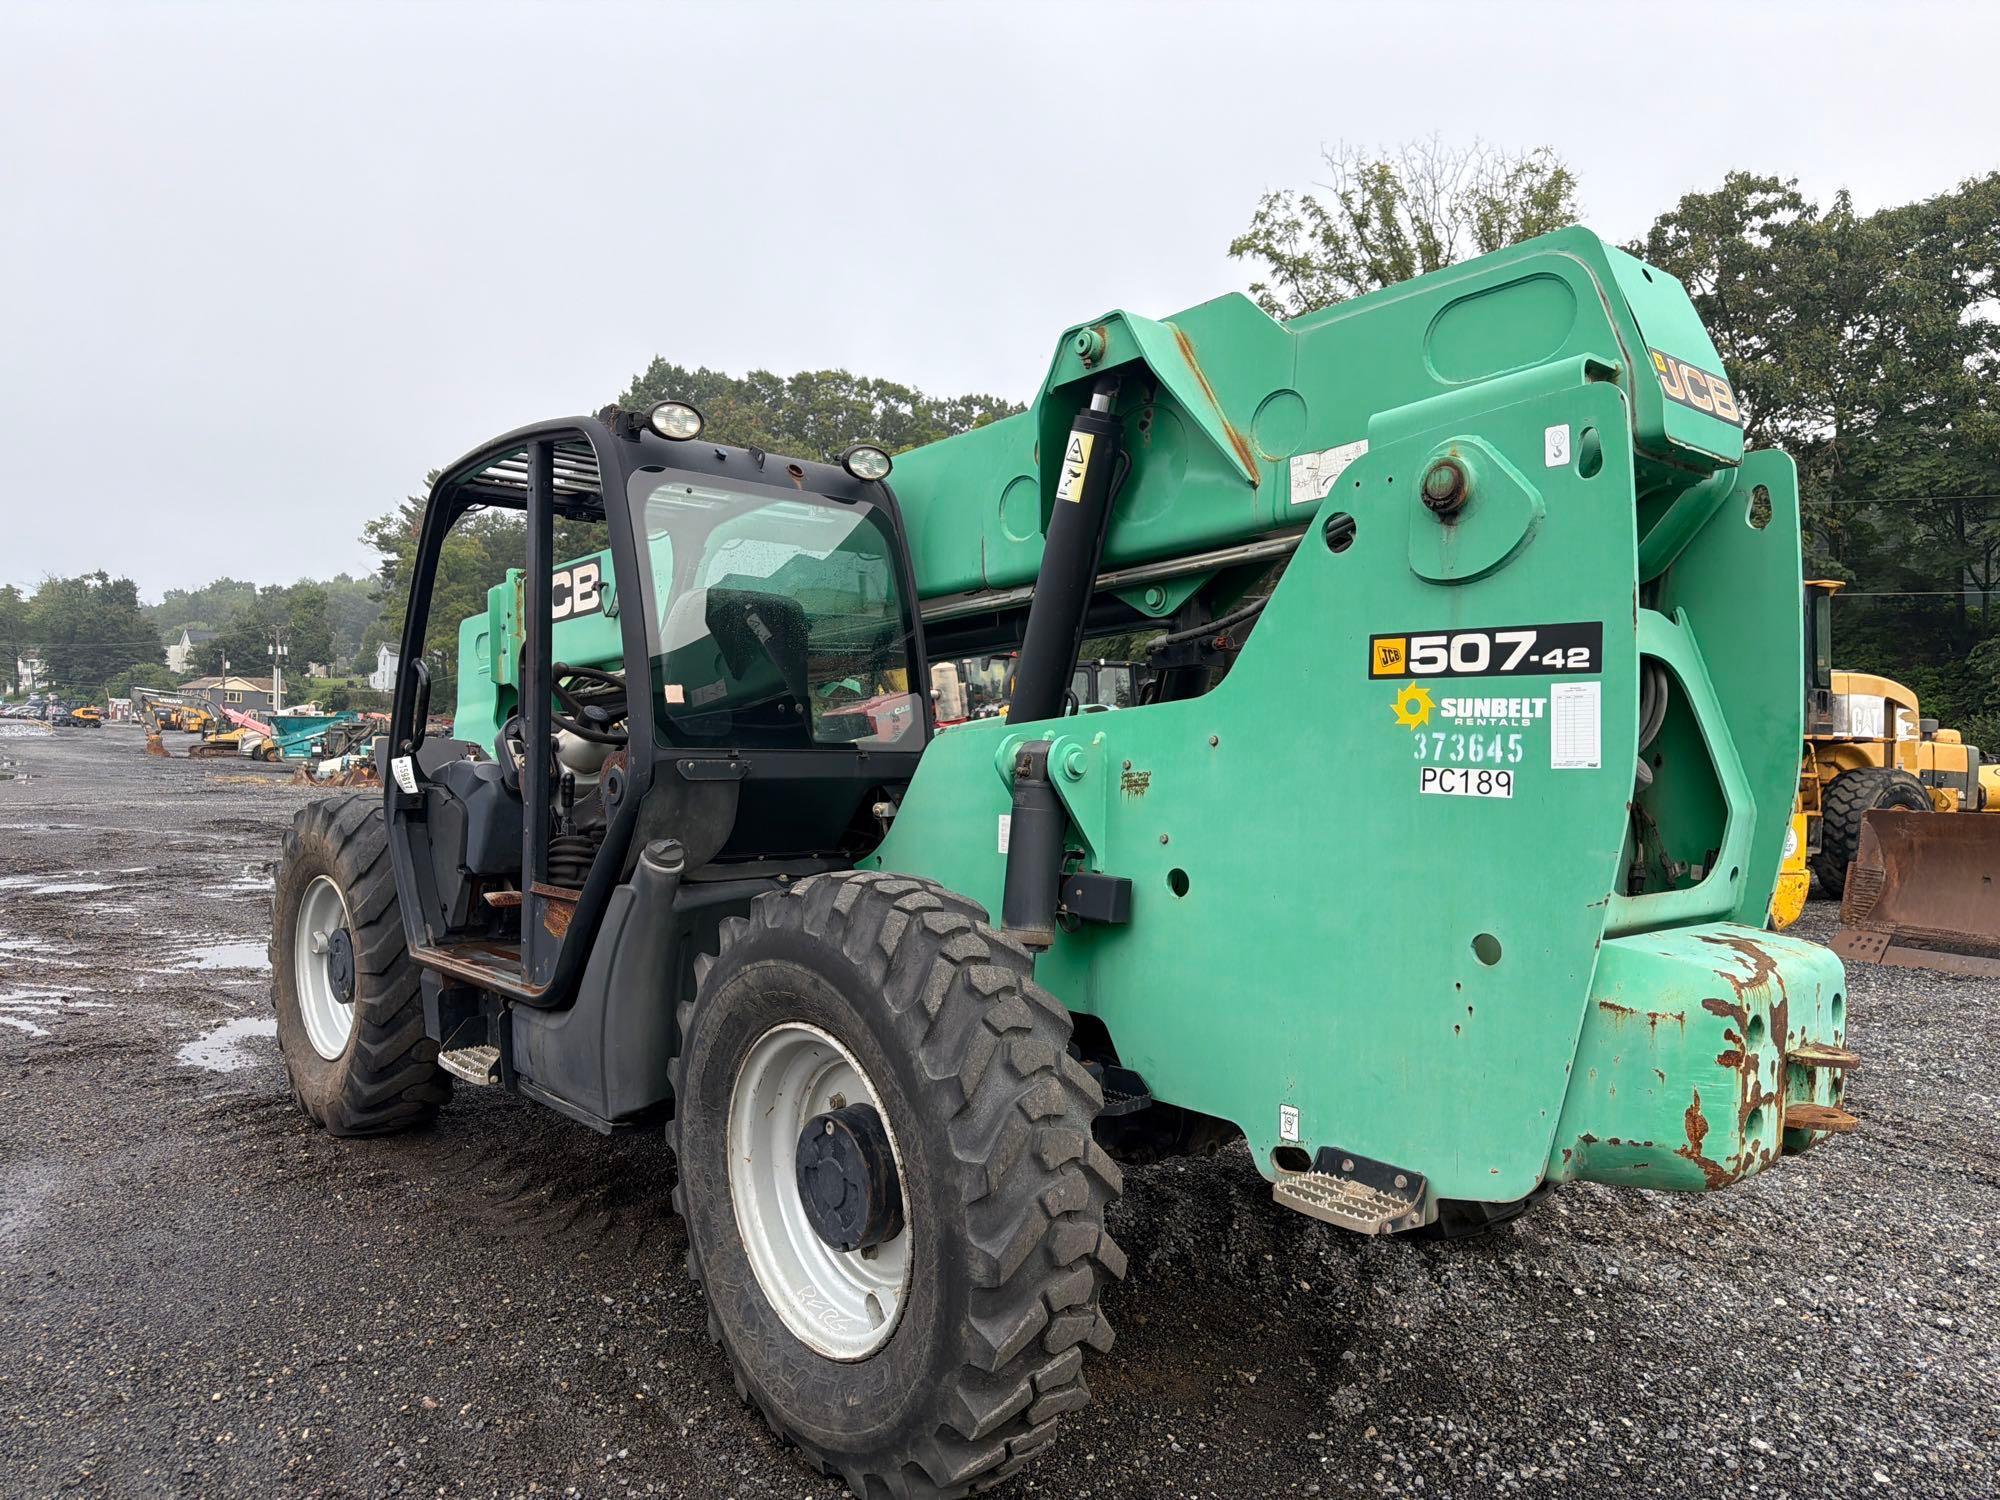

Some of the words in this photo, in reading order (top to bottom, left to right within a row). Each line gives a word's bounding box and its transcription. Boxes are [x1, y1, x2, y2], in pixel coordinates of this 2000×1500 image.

[1660, 358, 1739, 421] JCB
[552, 563, 600, 619] CB
[1382, 648, 1400, 665] JCB
[1409, 631, 1590, 674] 507-42
[1440, 698, 1547, 718] SUNBELT
[1455, 719, 1531, 727] RENTALS
[1851, 706, 1882, 738] CAT
[1413, 732, 1523, 763] 373645
[399, 764, 413, 788] 159817
[1421, 767, 1512, 797] PC189
